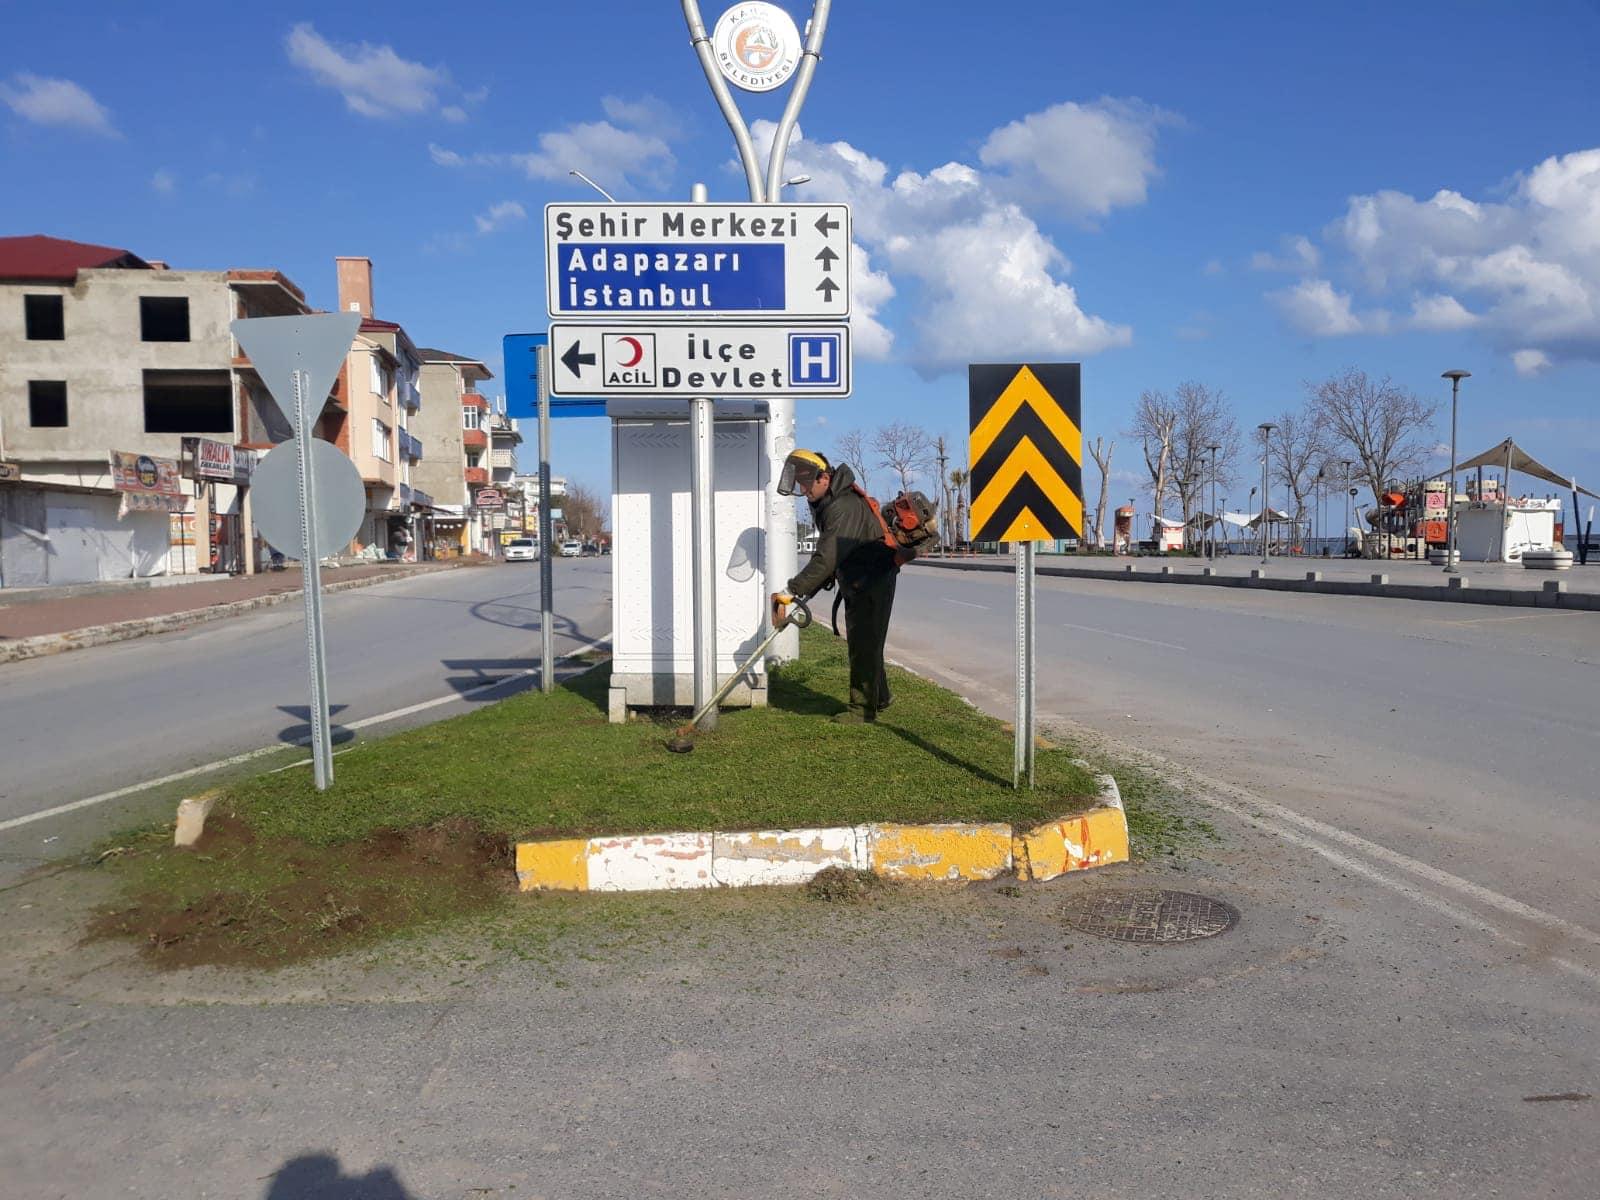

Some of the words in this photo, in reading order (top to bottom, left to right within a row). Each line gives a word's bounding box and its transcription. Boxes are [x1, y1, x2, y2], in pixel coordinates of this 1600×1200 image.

[556, 212, 647, 240] Şehir
[662, 212, 797, 237] Merkezi
[568, 248, 740, 276] Adapazarı
[569, 277, 712, 306] İstanbul
[687, 333, 756, 363] İlçe
[800, 341, 830, 378] H
[608, 368, 652, 384] ACİL
[662, 367, 783, 388] Devlet
